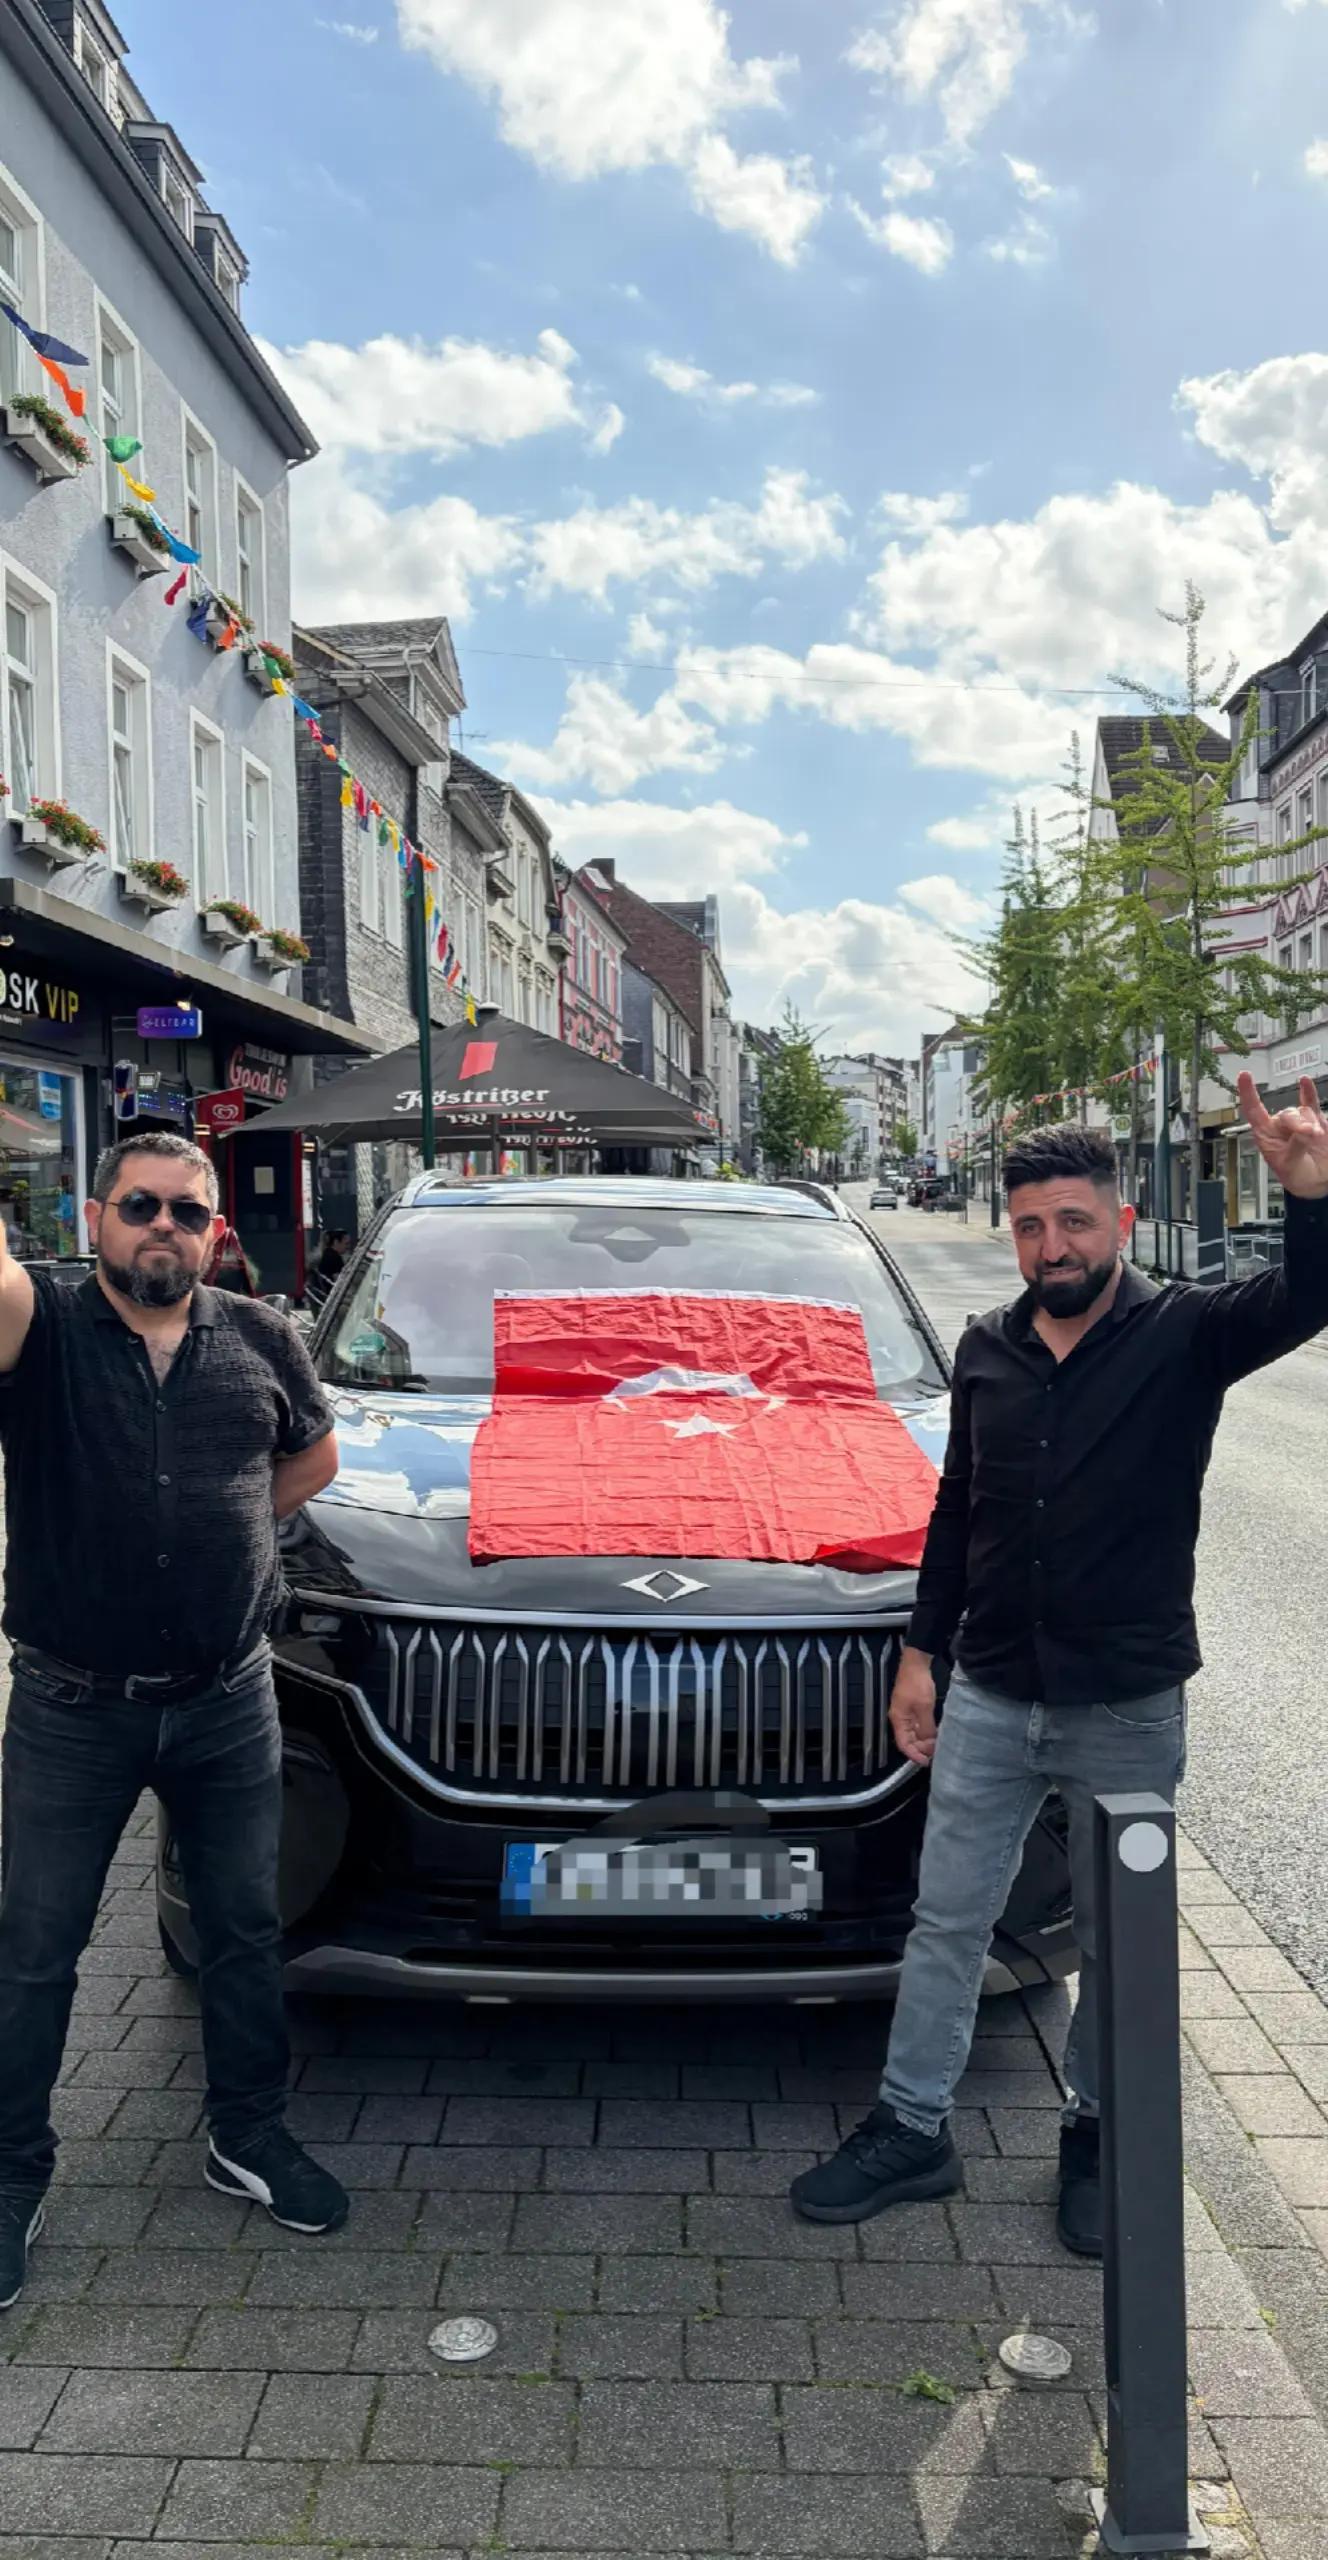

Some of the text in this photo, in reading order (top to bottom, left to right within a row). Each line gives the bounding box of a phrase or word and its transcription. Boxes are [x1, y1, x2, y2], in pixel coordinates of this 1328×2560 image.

[45, 983, 79, 1023] VIP
[230, 1045, 273, 1095] Good
[393, 1087, 550, 1112] Köstritzer
